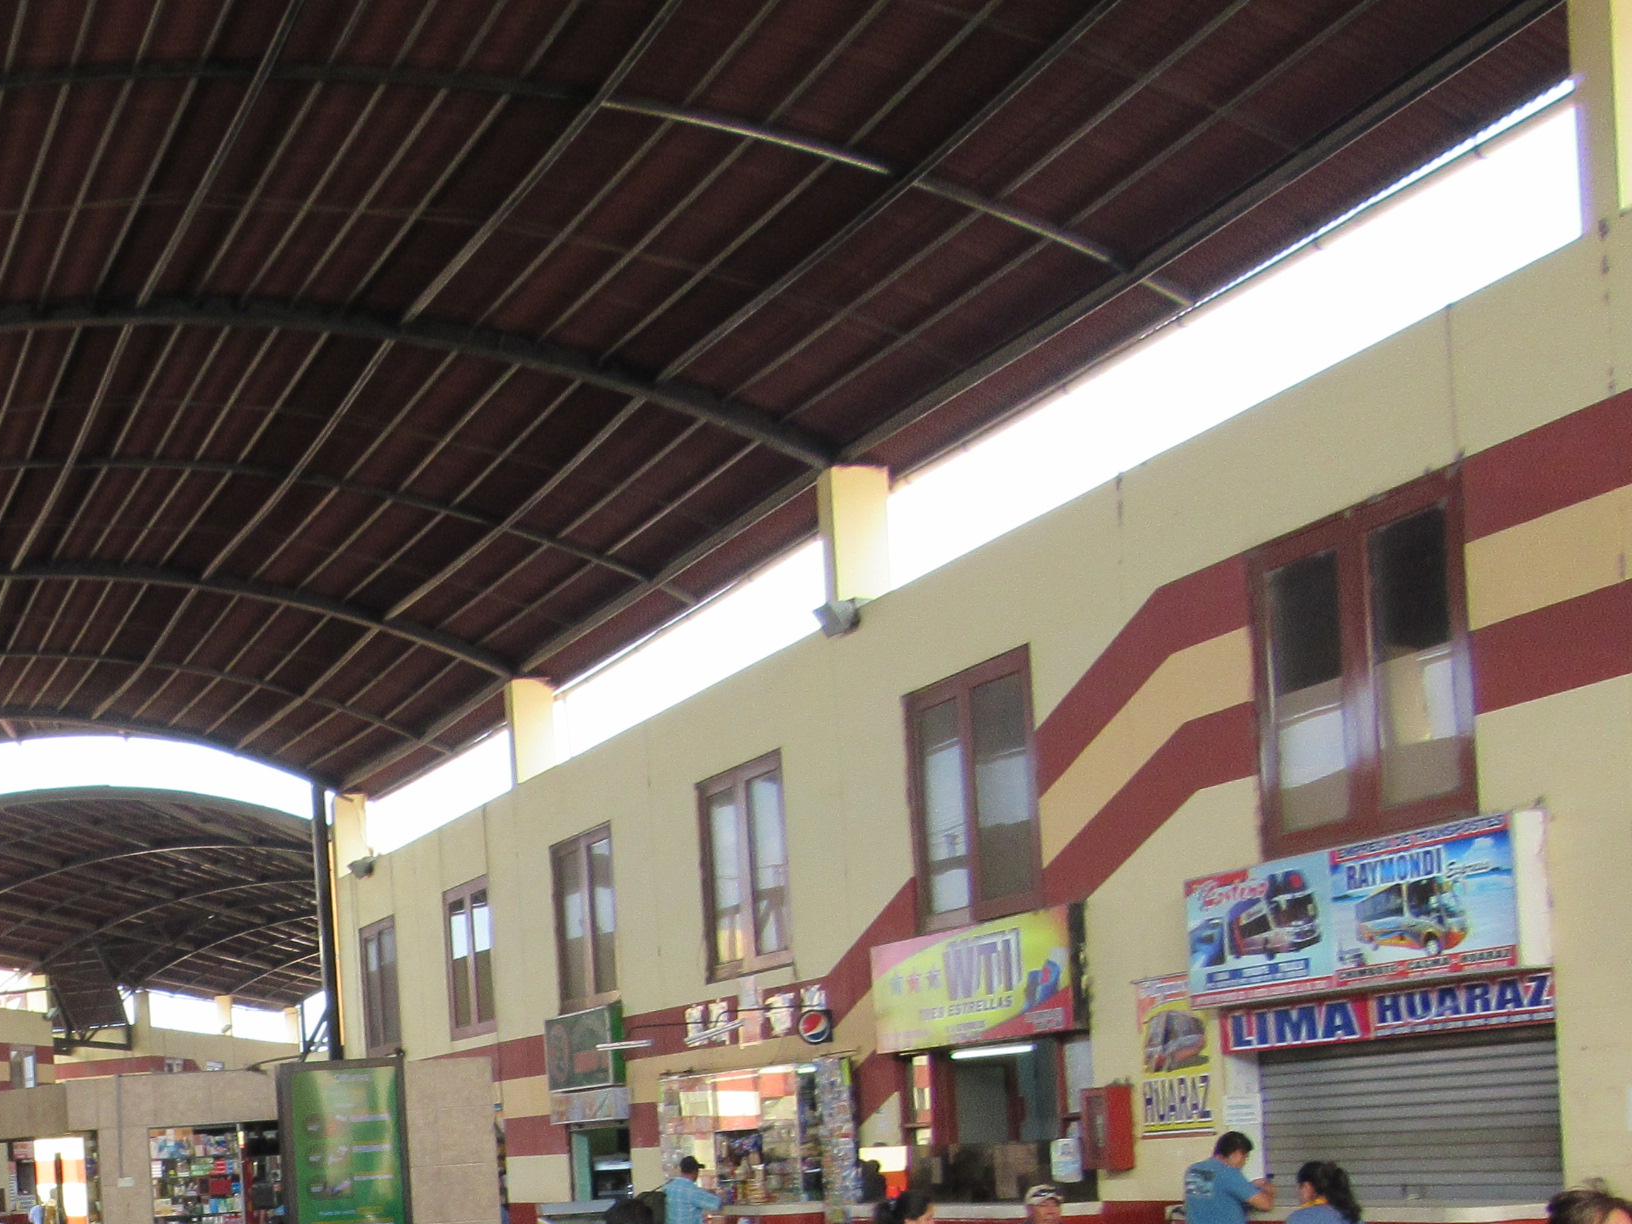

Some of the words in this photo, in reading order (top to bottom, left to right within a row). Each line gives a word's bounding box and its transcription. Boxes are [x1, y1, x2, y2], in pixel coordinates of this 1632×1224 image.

[1346, 847, 1444, 891] RAYMONDI
[947, 995, 1014, 1017] ESTRELLAS
[1230, 1001, 1360, 1050] LIMA
[1373, 971, 1554, 1027] HUARAZ
[1142, 1074, 1213, 1125] HUARAZ
